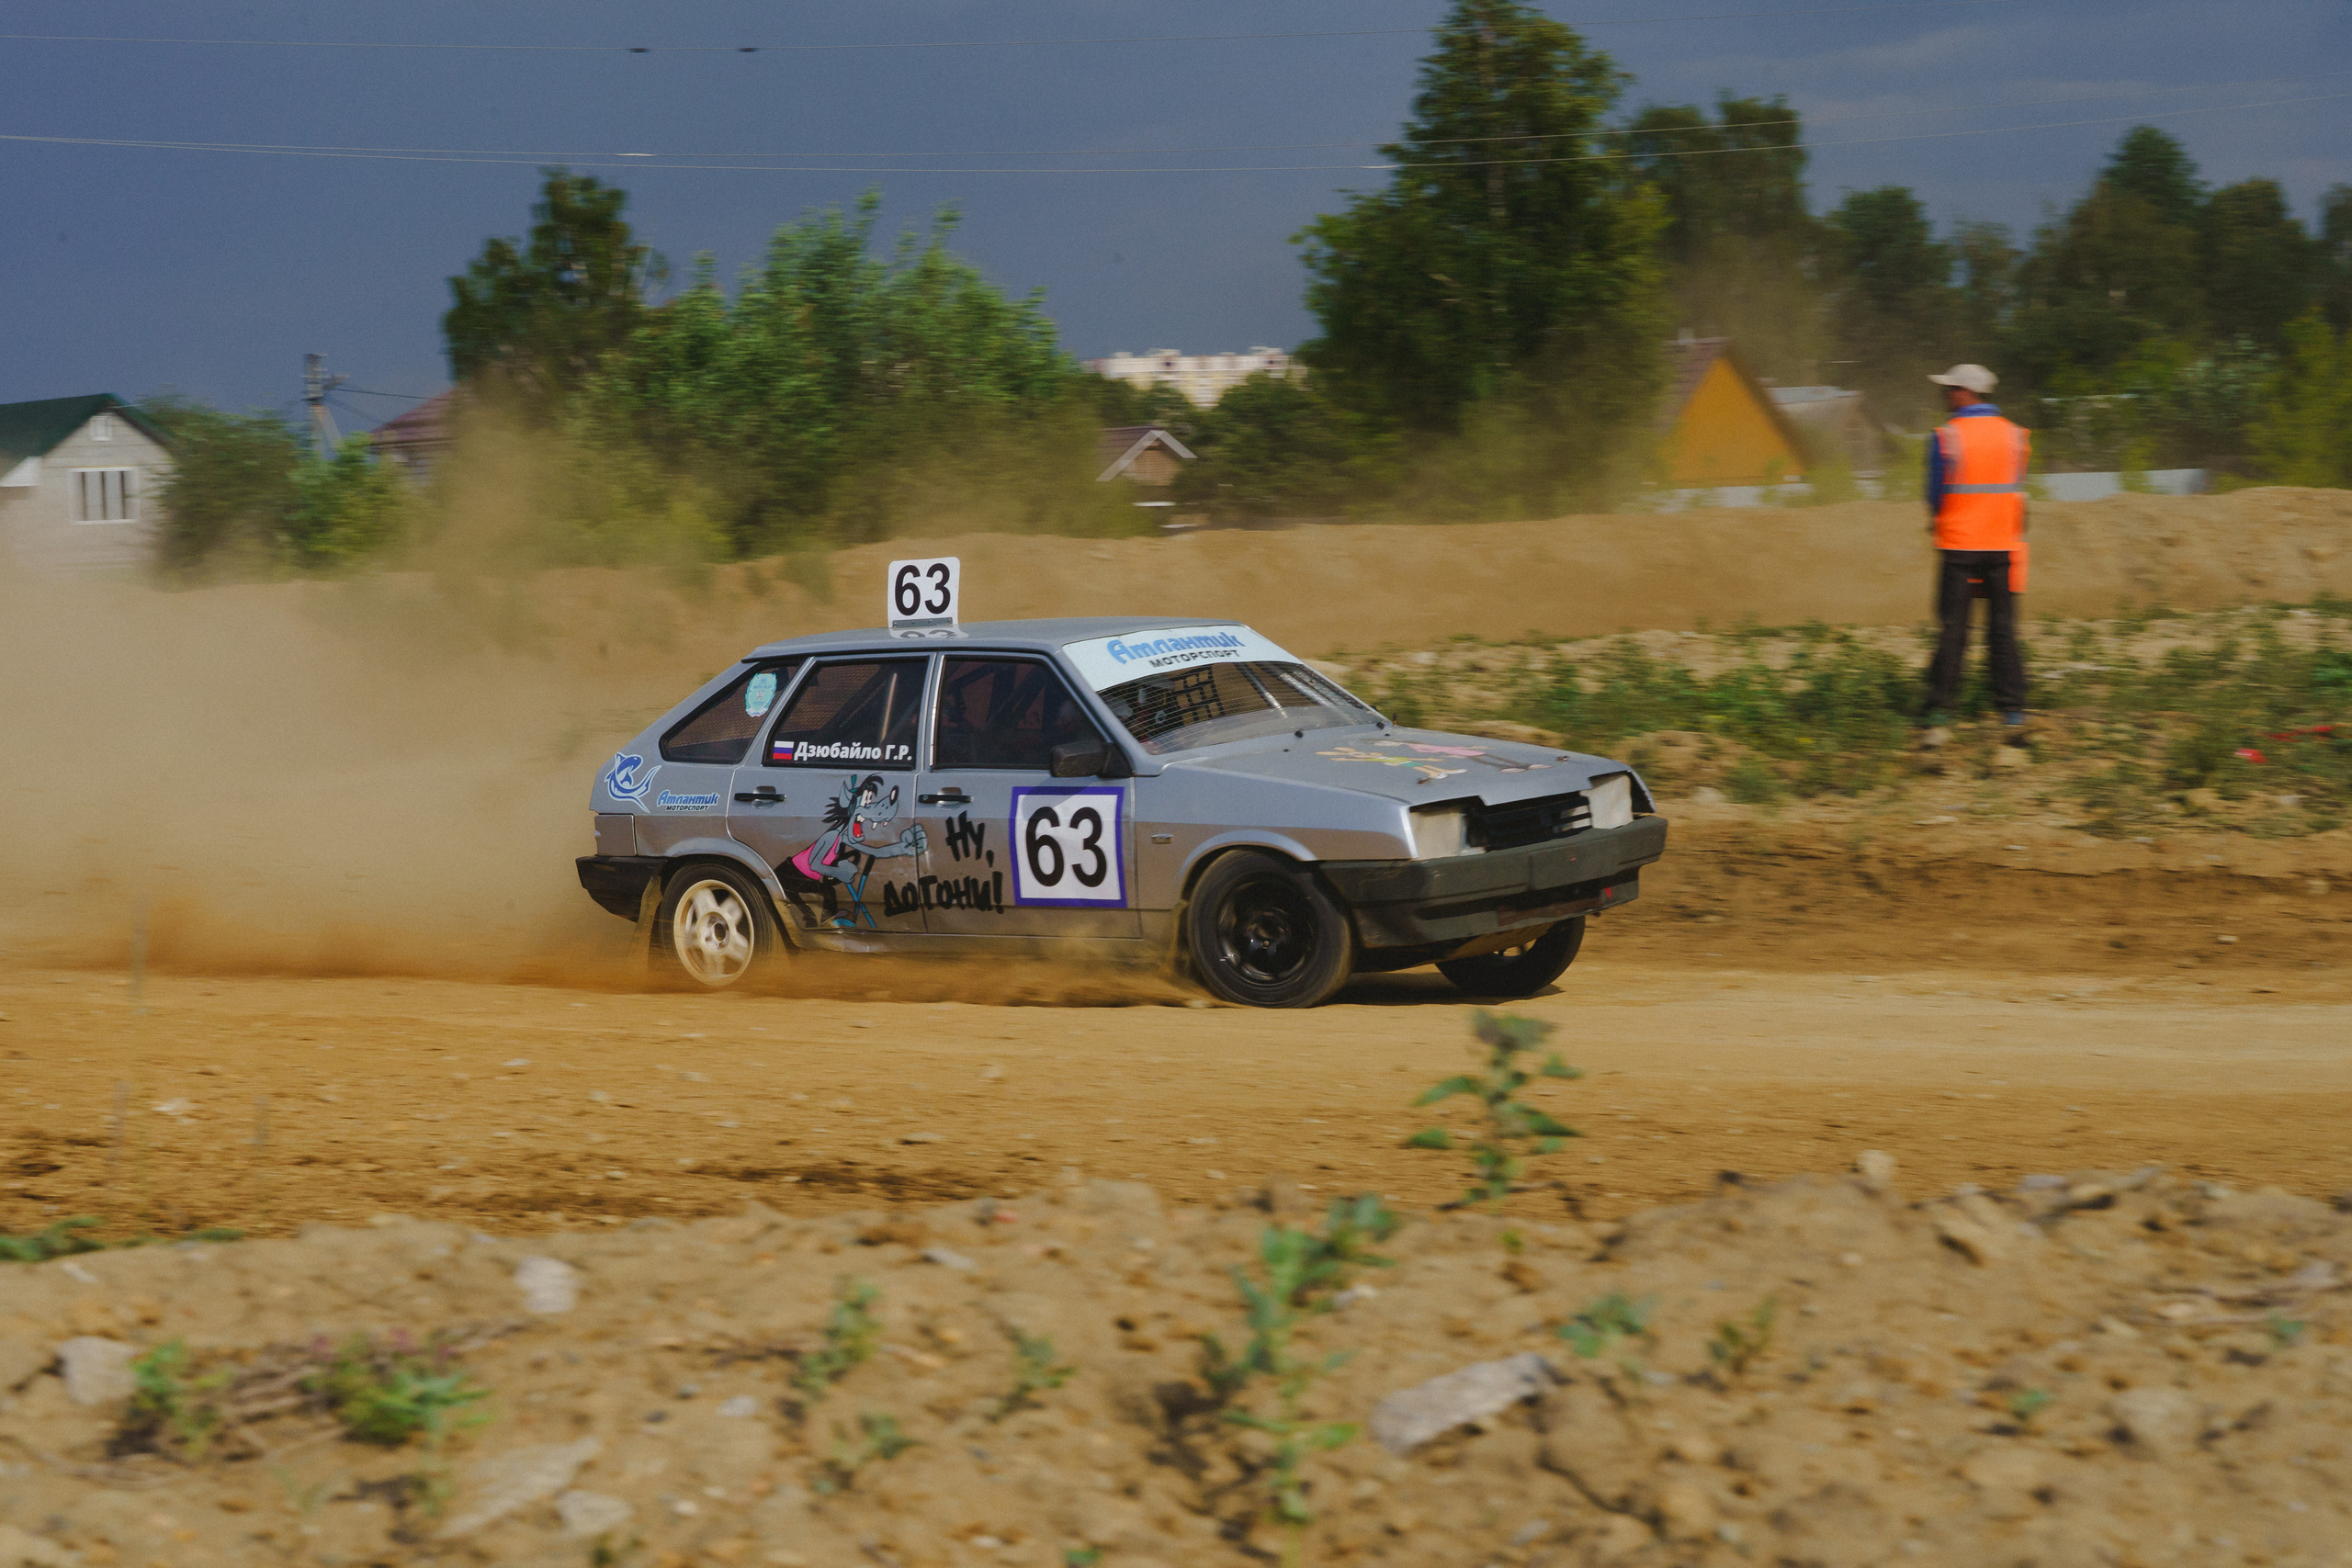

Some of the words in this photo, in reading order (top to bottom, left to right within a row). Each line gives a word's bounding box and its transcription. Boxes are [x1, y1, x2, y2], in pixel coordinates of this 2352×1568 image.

[894, 562, 951, 616] 63
[1106, 631, 1247, 665] Атлантик
[1148, 649, 1241, 669] МОТОРСПОРТ
[794, 741, 881, 761] Дзюбайло
[885, 744, 912, 761] Г.Р.
[657, 790, 719, 806] Атлантик
[1025, 807, 1107, 887] 63
